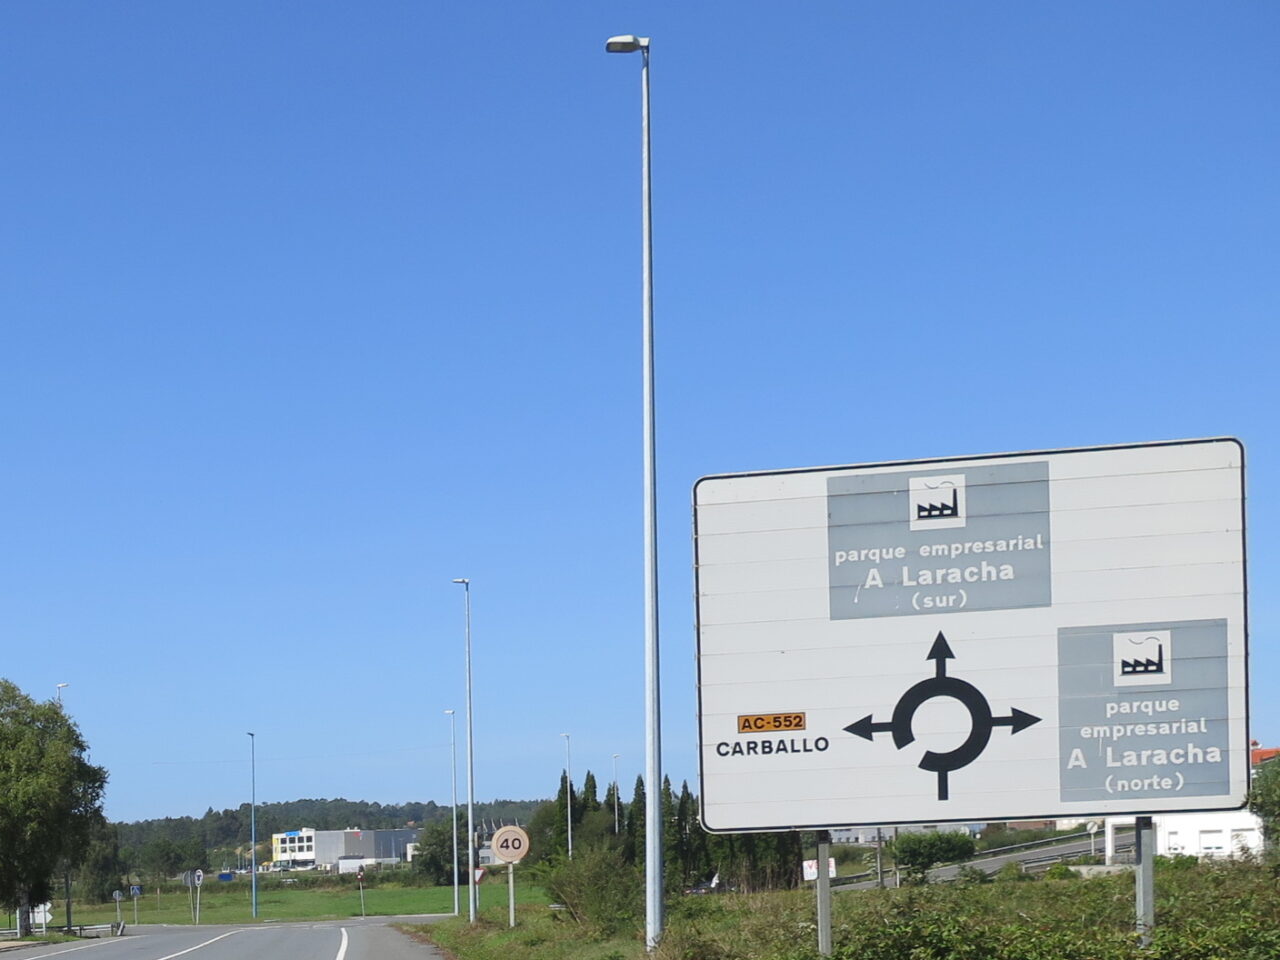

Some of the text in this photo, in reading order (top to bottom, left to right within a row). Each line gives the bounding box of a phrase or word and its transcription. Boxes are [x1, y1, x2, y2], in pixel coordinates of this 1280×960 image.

[835, 534, 1043, 566] parque empresarial
[864, 561, 1014, 588] A Laracha
[912, 589, 967, 609] (sur)
[1106, 699, 1180, 718] parque
[741, 715, 803, 730] AC-552
[1080, 717, 1207, 741] empresarial
[716, 737, 829, 756] CARBALLO
[1067, 743, 1222, 769] A Laracha
[1105, 772, 1184, 793] (norte)
[500, 838, 522, 850] 40
